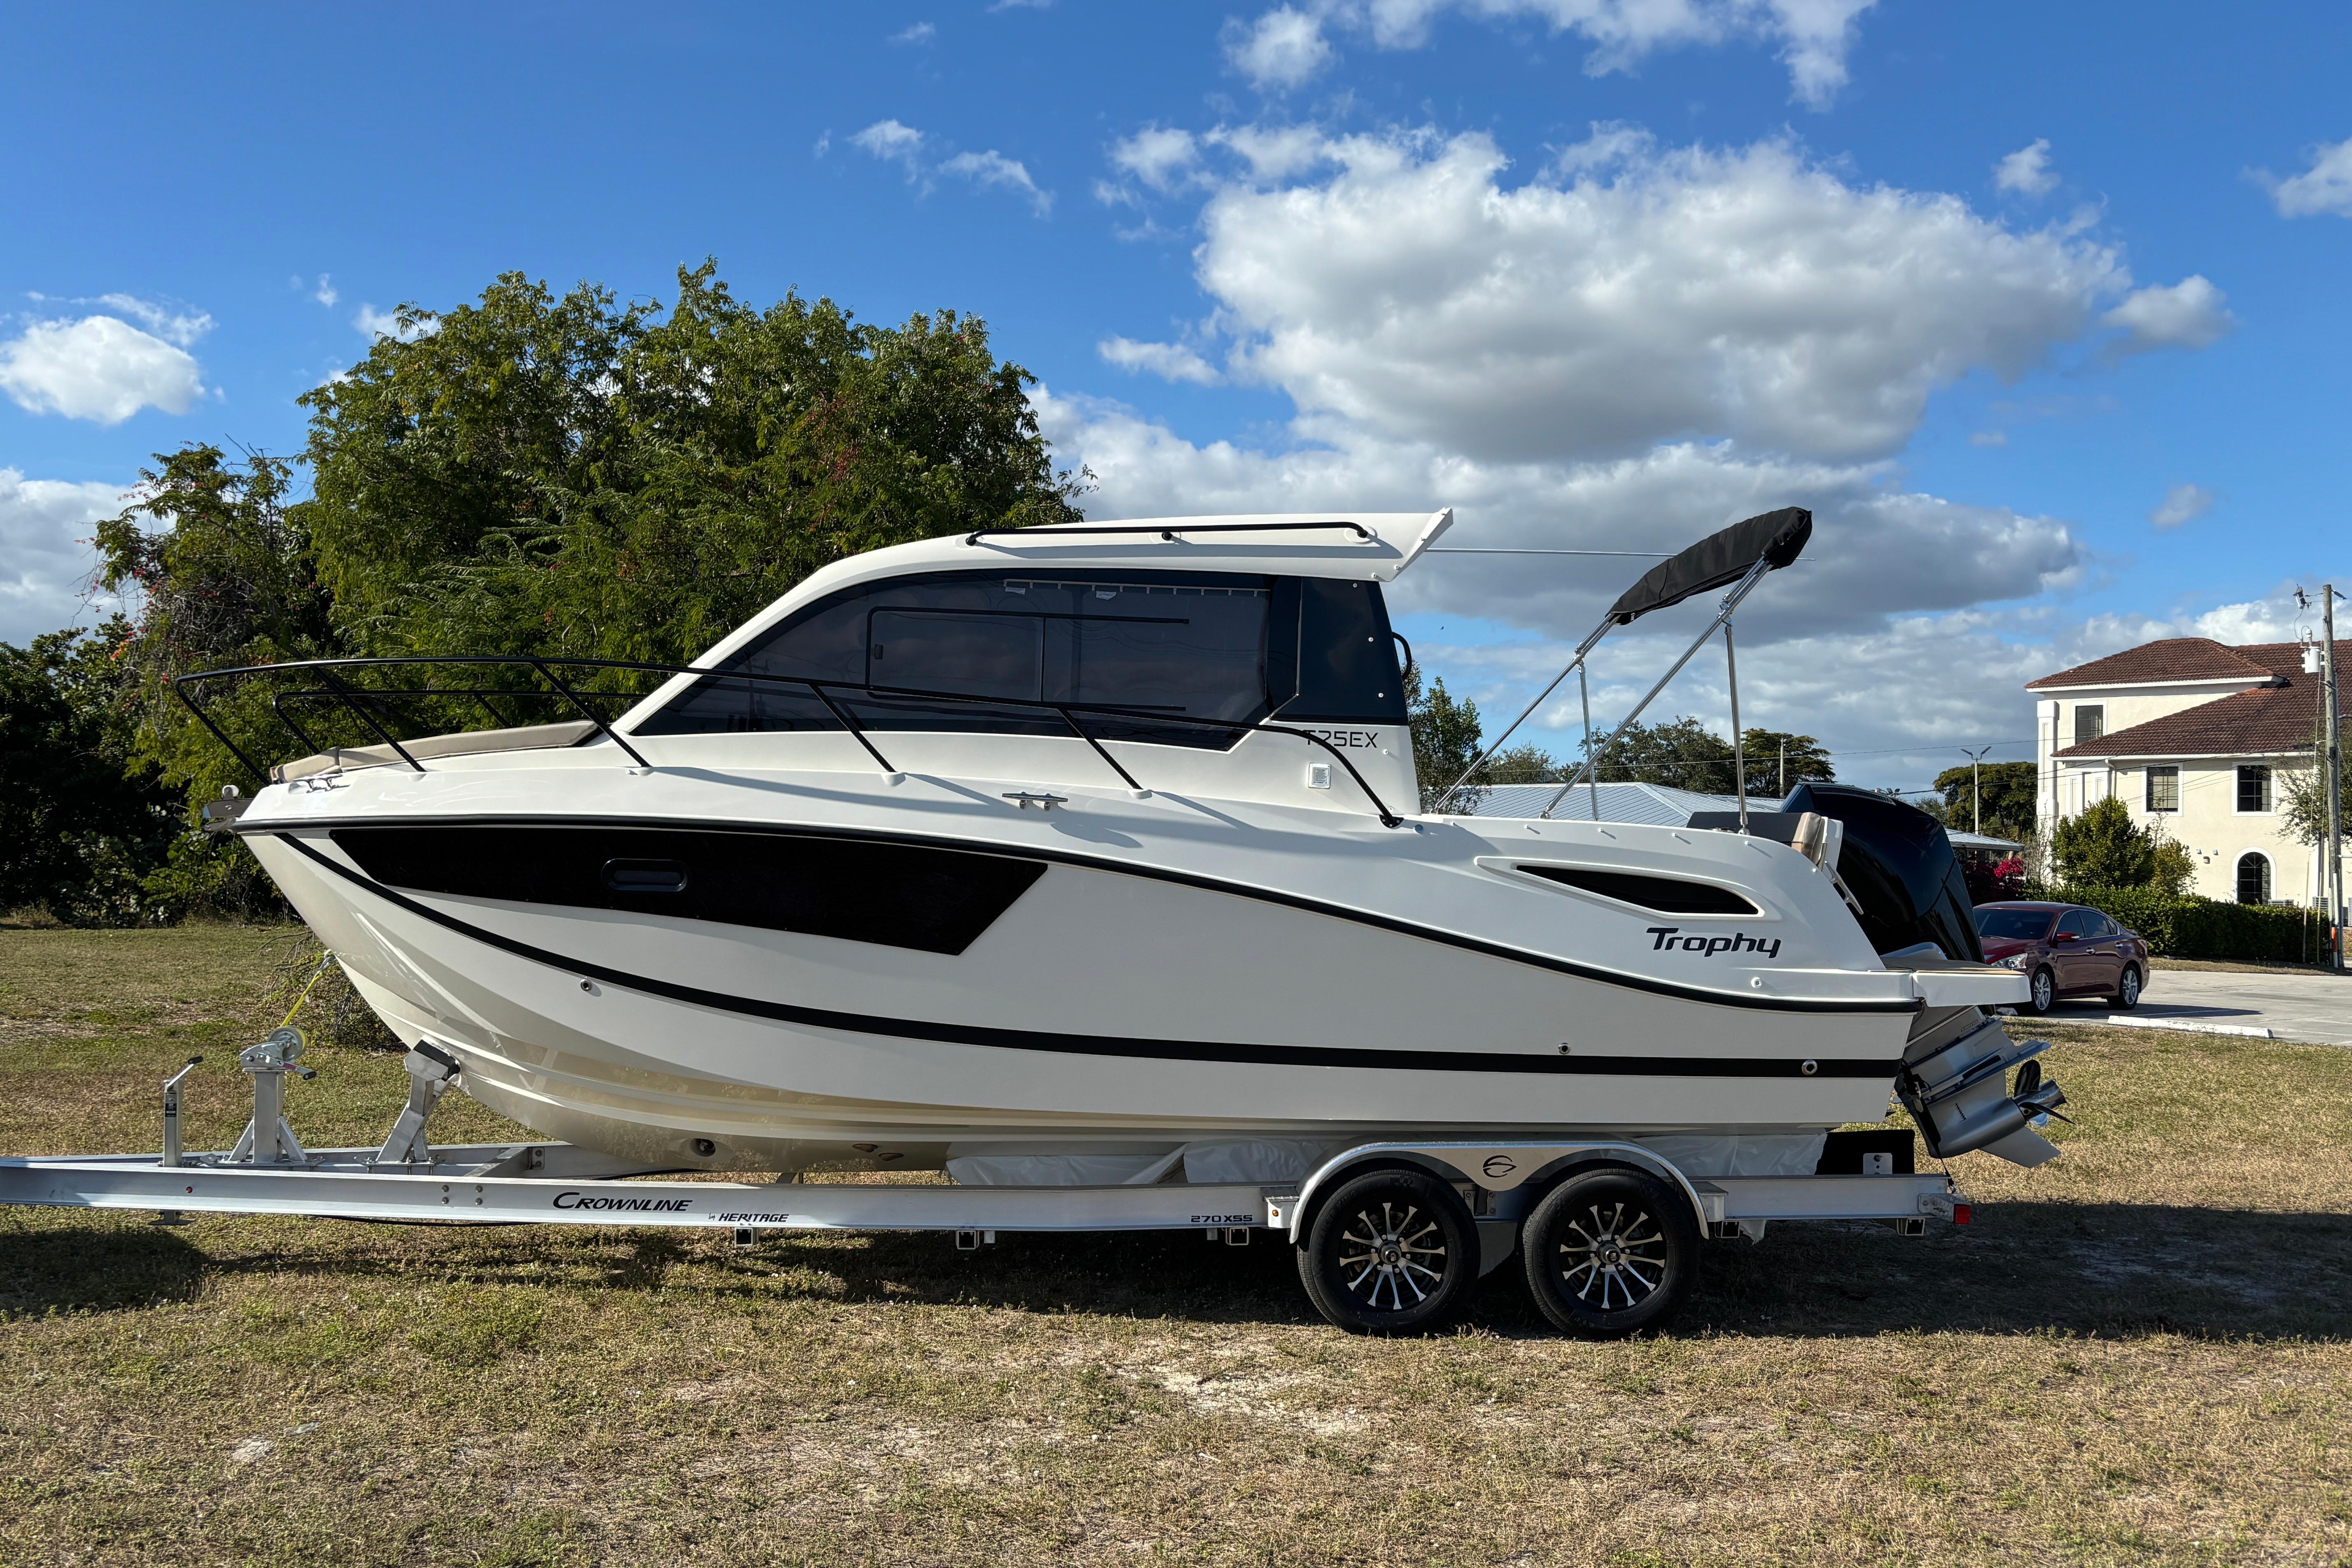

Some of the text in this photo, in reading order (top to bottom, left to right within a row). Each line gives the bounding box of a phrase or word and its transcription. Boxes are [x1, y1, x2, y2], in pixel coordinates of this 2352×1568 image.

[1646, 927, 1782, 959] Trophy
[552, 1192, 693, 1212] CROWNLINE
[719, 1213, 790, 1222] HERITAGE
